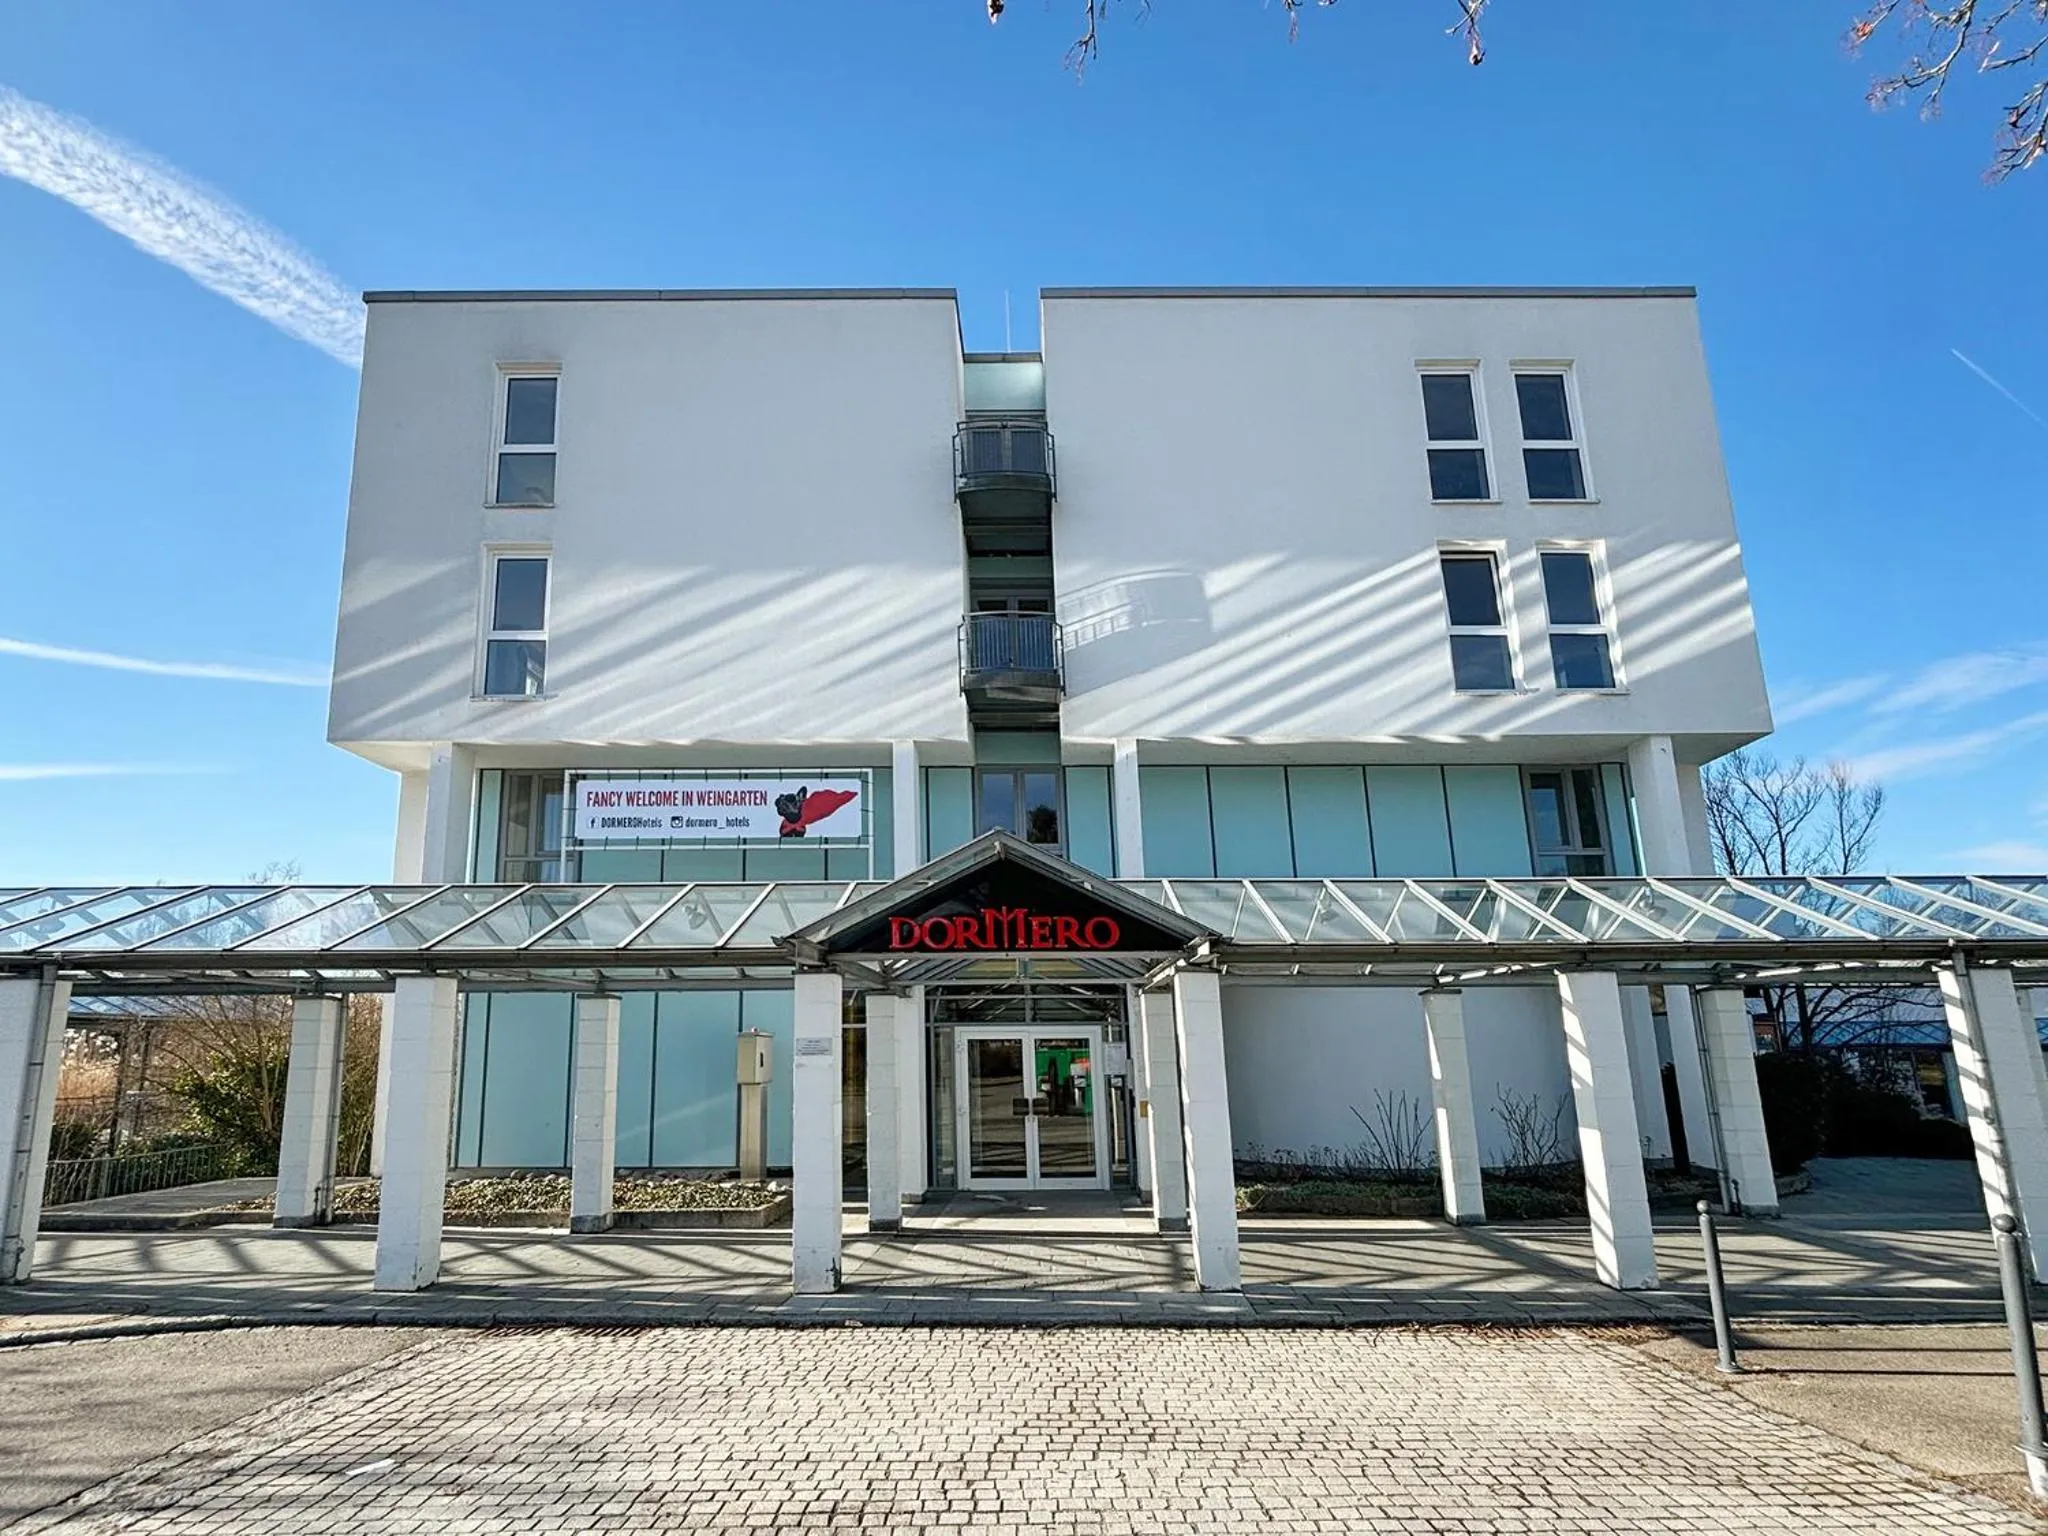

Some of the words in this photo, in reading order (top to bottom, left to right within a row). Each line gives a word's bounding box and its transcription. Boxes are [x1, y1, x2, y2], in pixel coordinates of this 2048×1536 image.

[586, 791, 623, 807] FANCY
[626, 790, 679, 807] WELCOME
[682, 790, 693, 806] IN
[696, 790, 768, 806] WEINGARTEN
[888, 906, 1120, 949] DORMERO
